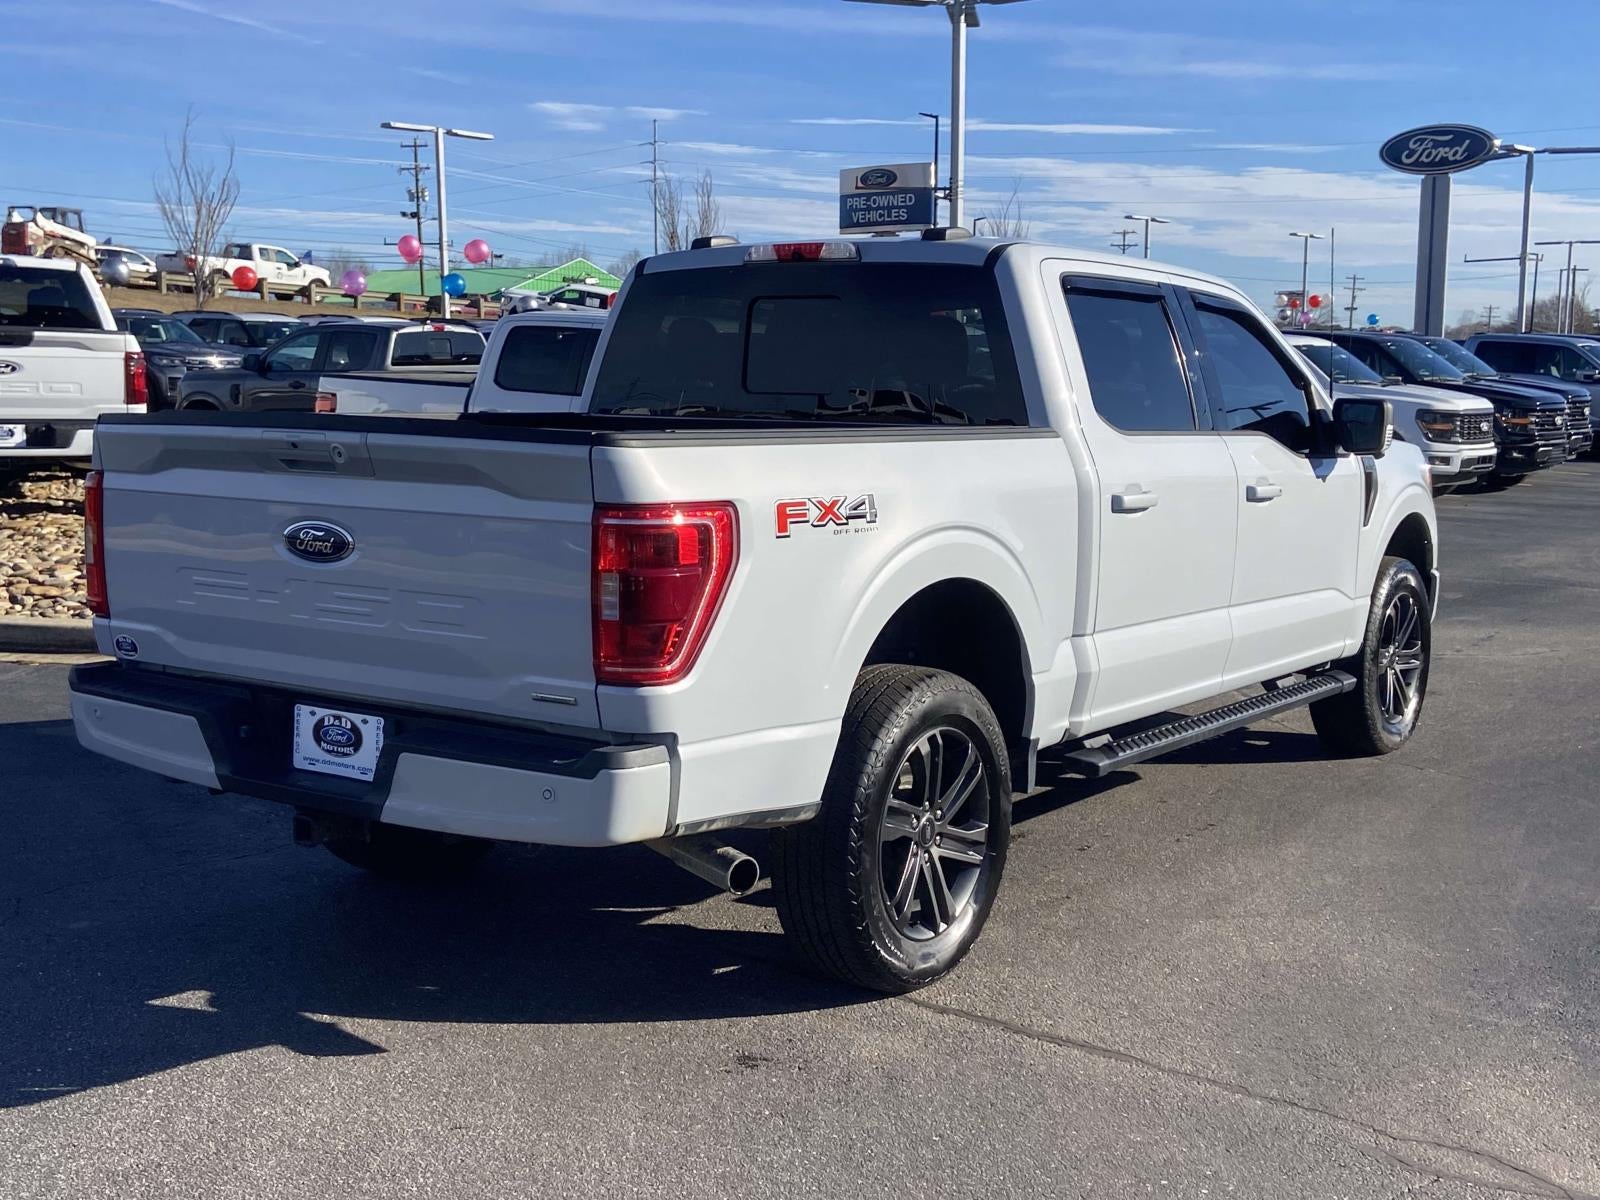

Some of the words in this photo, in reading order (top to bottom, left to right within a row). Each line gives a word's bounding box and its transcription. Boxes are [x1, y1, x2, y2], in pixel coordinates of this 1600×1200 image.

[1401, 134, 1470, 164] Ford
[846, 193, 915, 209] PRE-OWNED
[852, 208, 908, 223] VEHICLES
[774, 493, 878, 539] FX4
[833, 528, 851, 536] OFF
[296, 528, 335, 554] Ford
[323, 715, 352, 729] D&D
[326, 728, 348, 743] Ford
[320, 741, 355, 754] MOTORS
